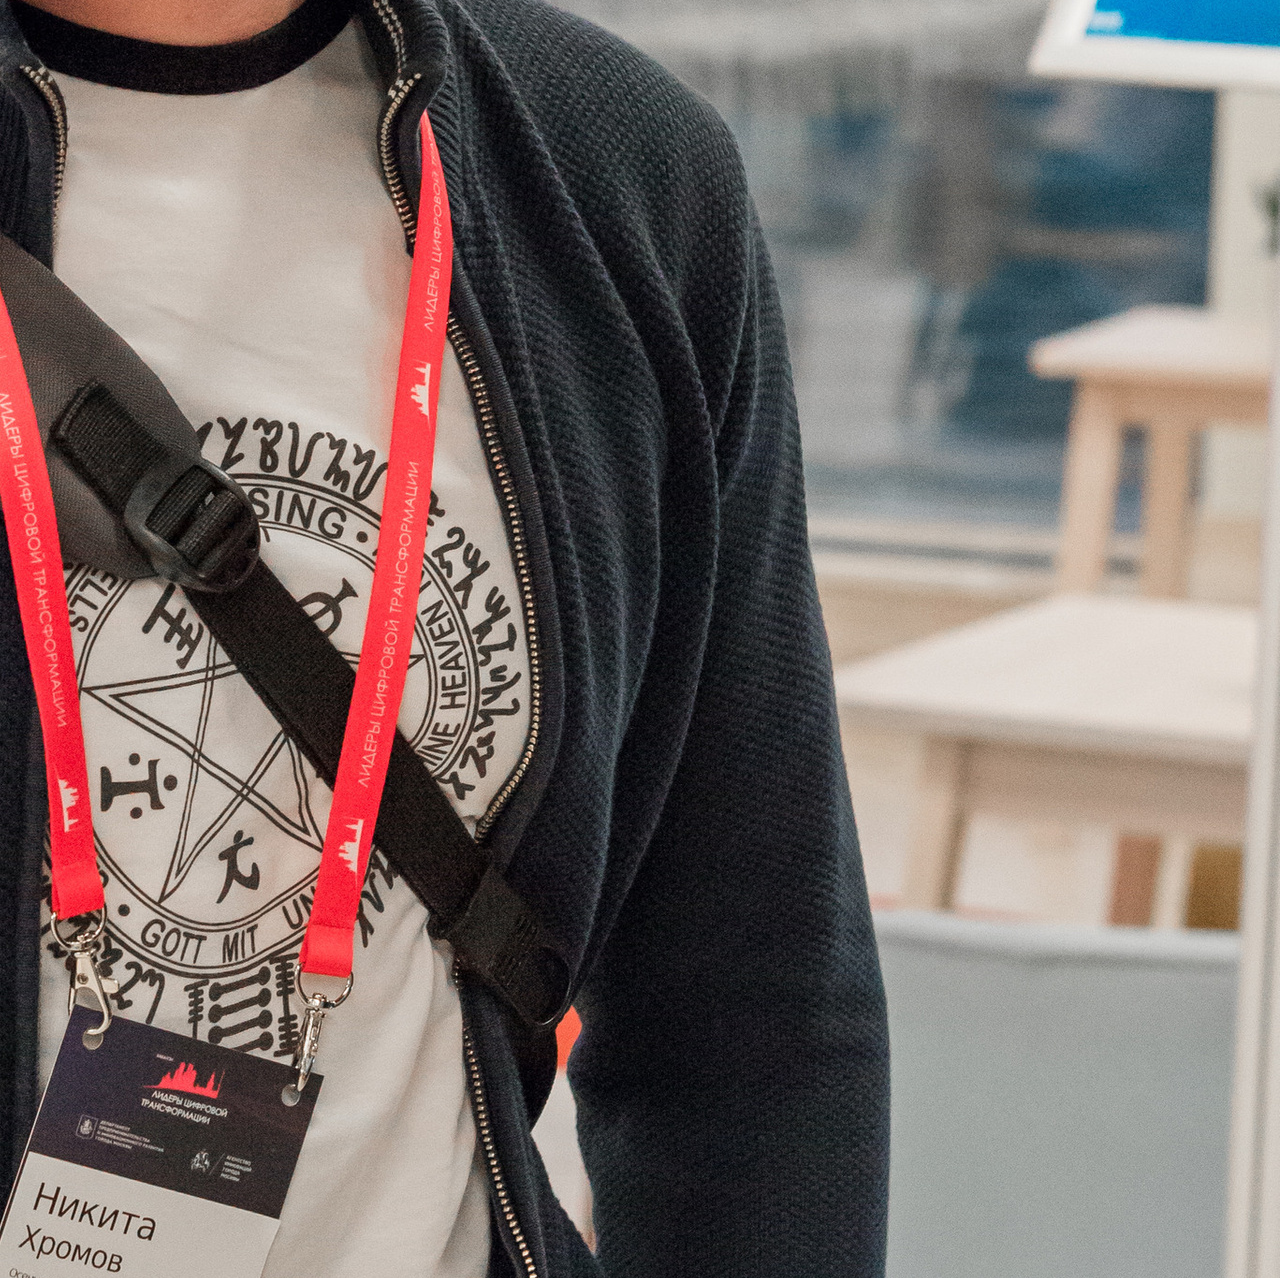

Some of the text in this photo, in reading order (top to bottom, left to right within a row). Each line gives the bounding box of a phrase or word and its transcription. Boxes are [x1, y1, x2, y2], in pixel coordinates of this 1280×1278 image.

[423, 265, 441, 332] ЛИДЕРЫ
[247, 487, 347, 539] SING
[13, 462, 47, 564] ЦИФРОВОЙ
[33, 569, 68, 728] ТРАНСФОРМАЦИИ
[68, 568, 119, 633] ELLS
[358, 461, 420, 789] ЛИДЕРЫ ЦИФРОВОЙ ТРАНСФОРМАЦИИ
[420, 599, 468, 710] HEAVEN
[417, 722, 461, 766] INE
[140, 885, 317, 964] GOTT MIT UN
[140, 1097, 211, 1125] ТРАНСФОРМАЦИИ
[151, 1090, 229, 1118] ЛИДЕРЫ ЦИФРОВОЙ
[32, 1182, 157, 1241] Никита
[18, 1224, 123, 1274] Хромов
